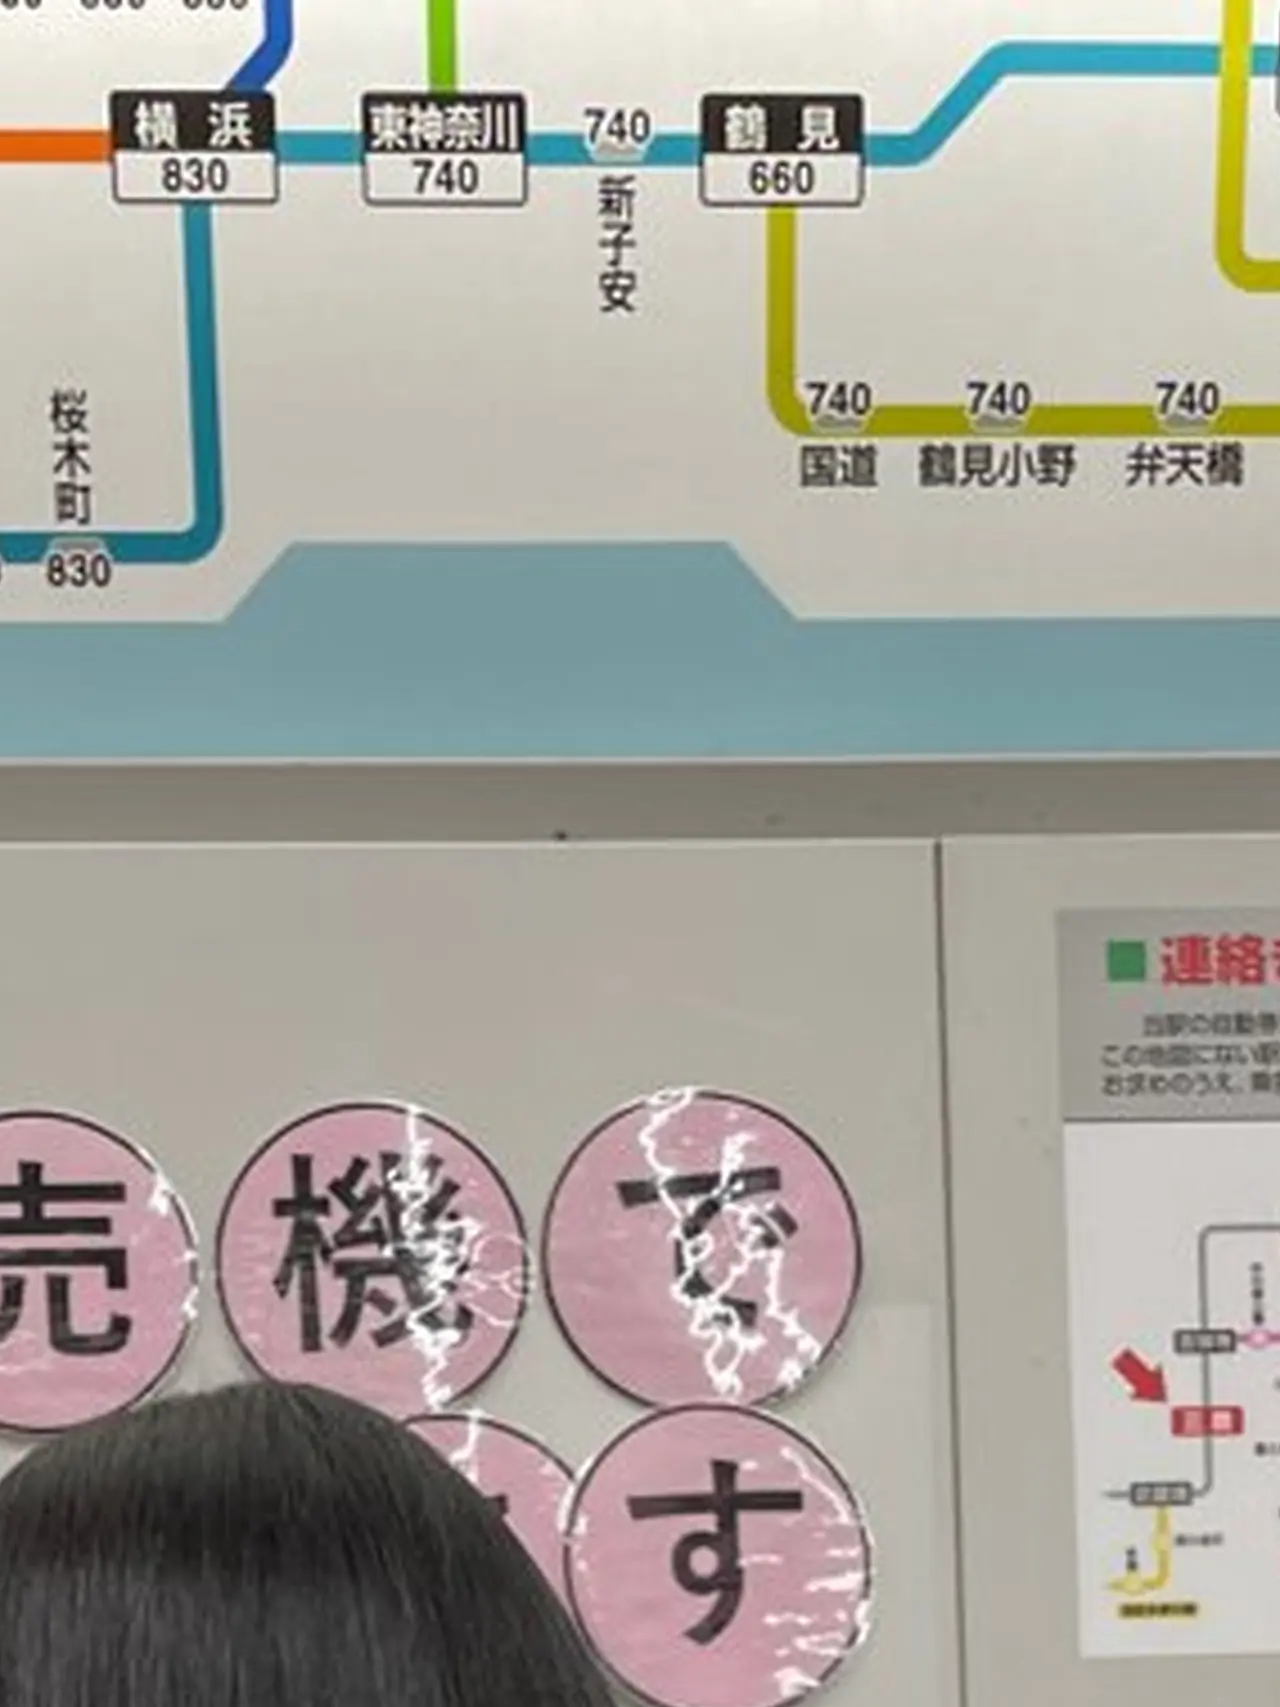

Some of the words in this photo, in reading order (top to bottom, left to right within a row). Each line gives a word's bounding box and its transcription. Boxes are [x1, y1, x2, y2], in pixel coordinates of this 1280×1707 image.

[133, 101, 252, 149] 横浜
[369, 103, 519, 150] 東神奈川
[584, 109, 650, 143] 740
[724, 106, 841, 151] 鶴見
[162, 157, 229, 193] 830
[412, 159, 478, 194] 740
[750, 159, 814, 194] 660
[600, 176, 636, 313] 新子安
[806, 382, 872, 416] 740
[967, 382, 1031, 416] 740
[1155, 381, 1219, 415] 740
[50, 389, 92, 525] 桜木町
[800, 445, 878, 487] 国道
[918, 443, 1075, 487] 鶴見小野
[1126, 442, 1245, 487] 弁天橋
[46, 553, 111, 588] 830
